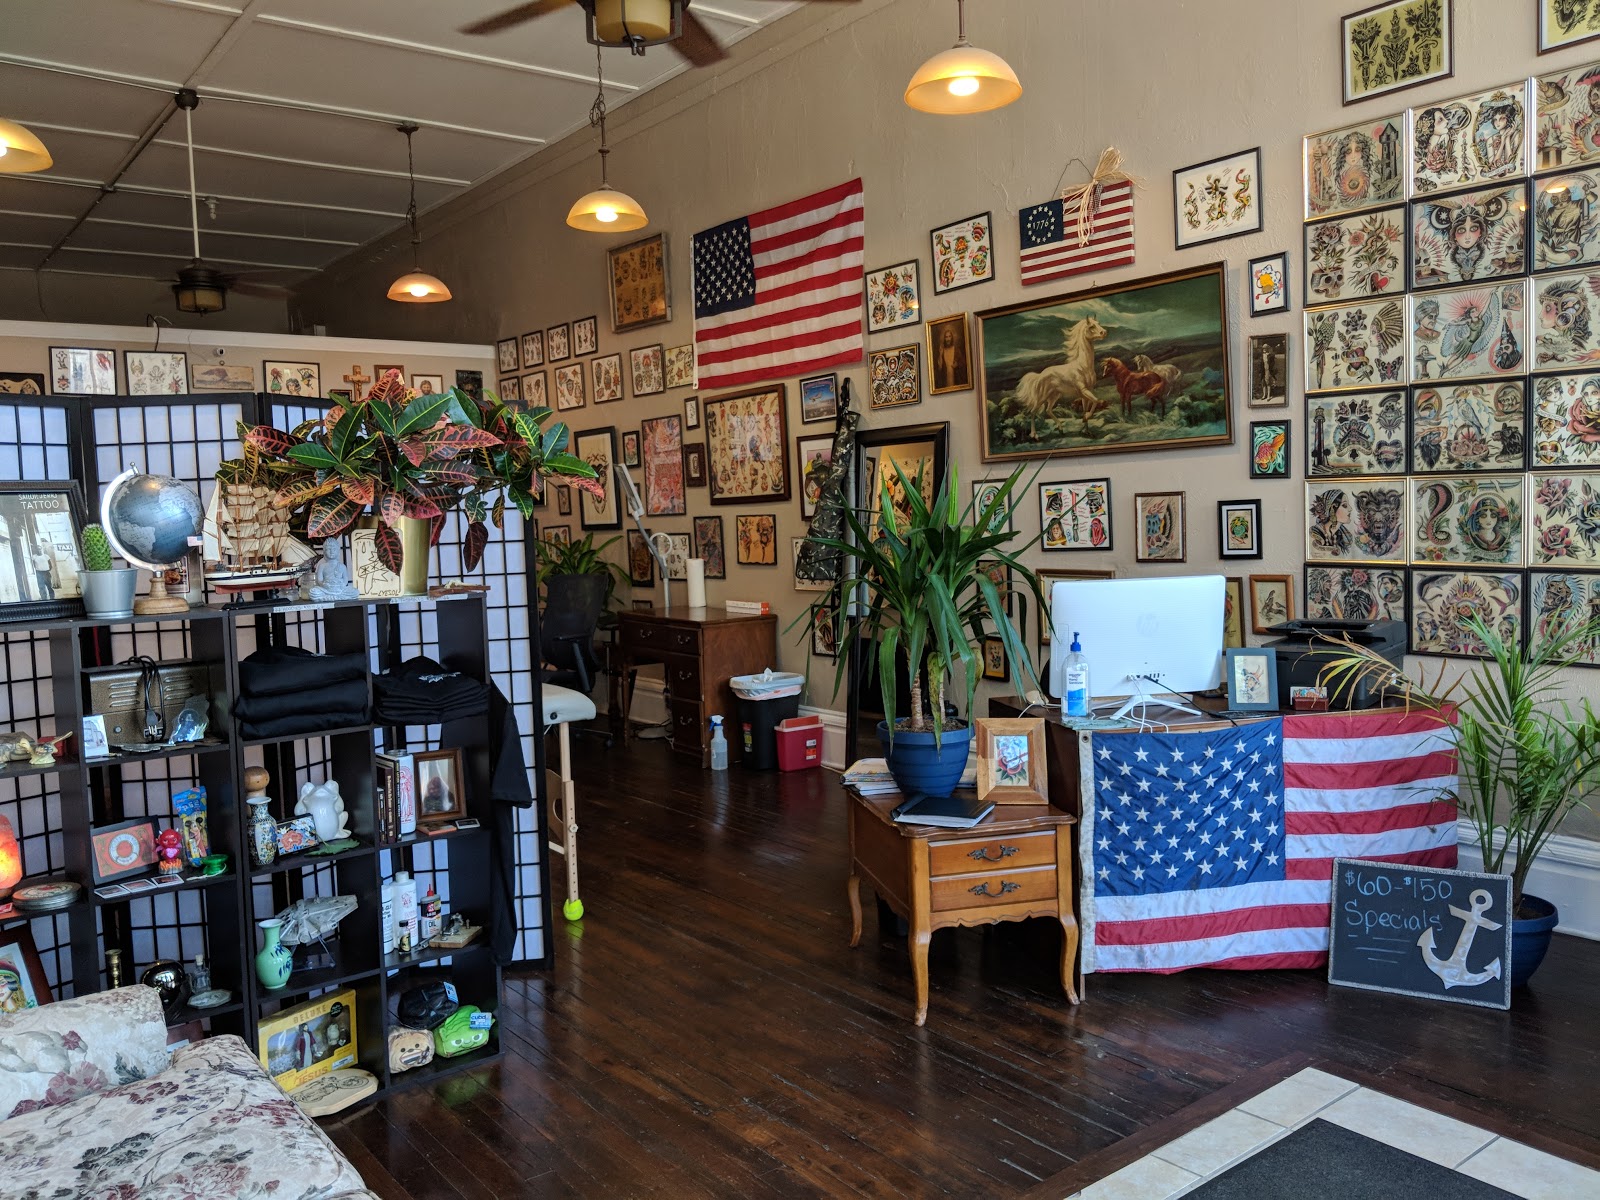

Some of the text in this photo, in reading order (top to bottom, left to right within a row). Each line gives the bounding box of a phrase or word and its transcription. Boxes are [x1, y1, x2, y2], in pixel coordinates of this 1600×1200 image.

[1032, 218, 1049, 230] 1776
[20, 499, 60, 510] TATTOO
[1344, 898, 1443, 934] Specials
[293, 1004, 327, 1024] DELUXE
